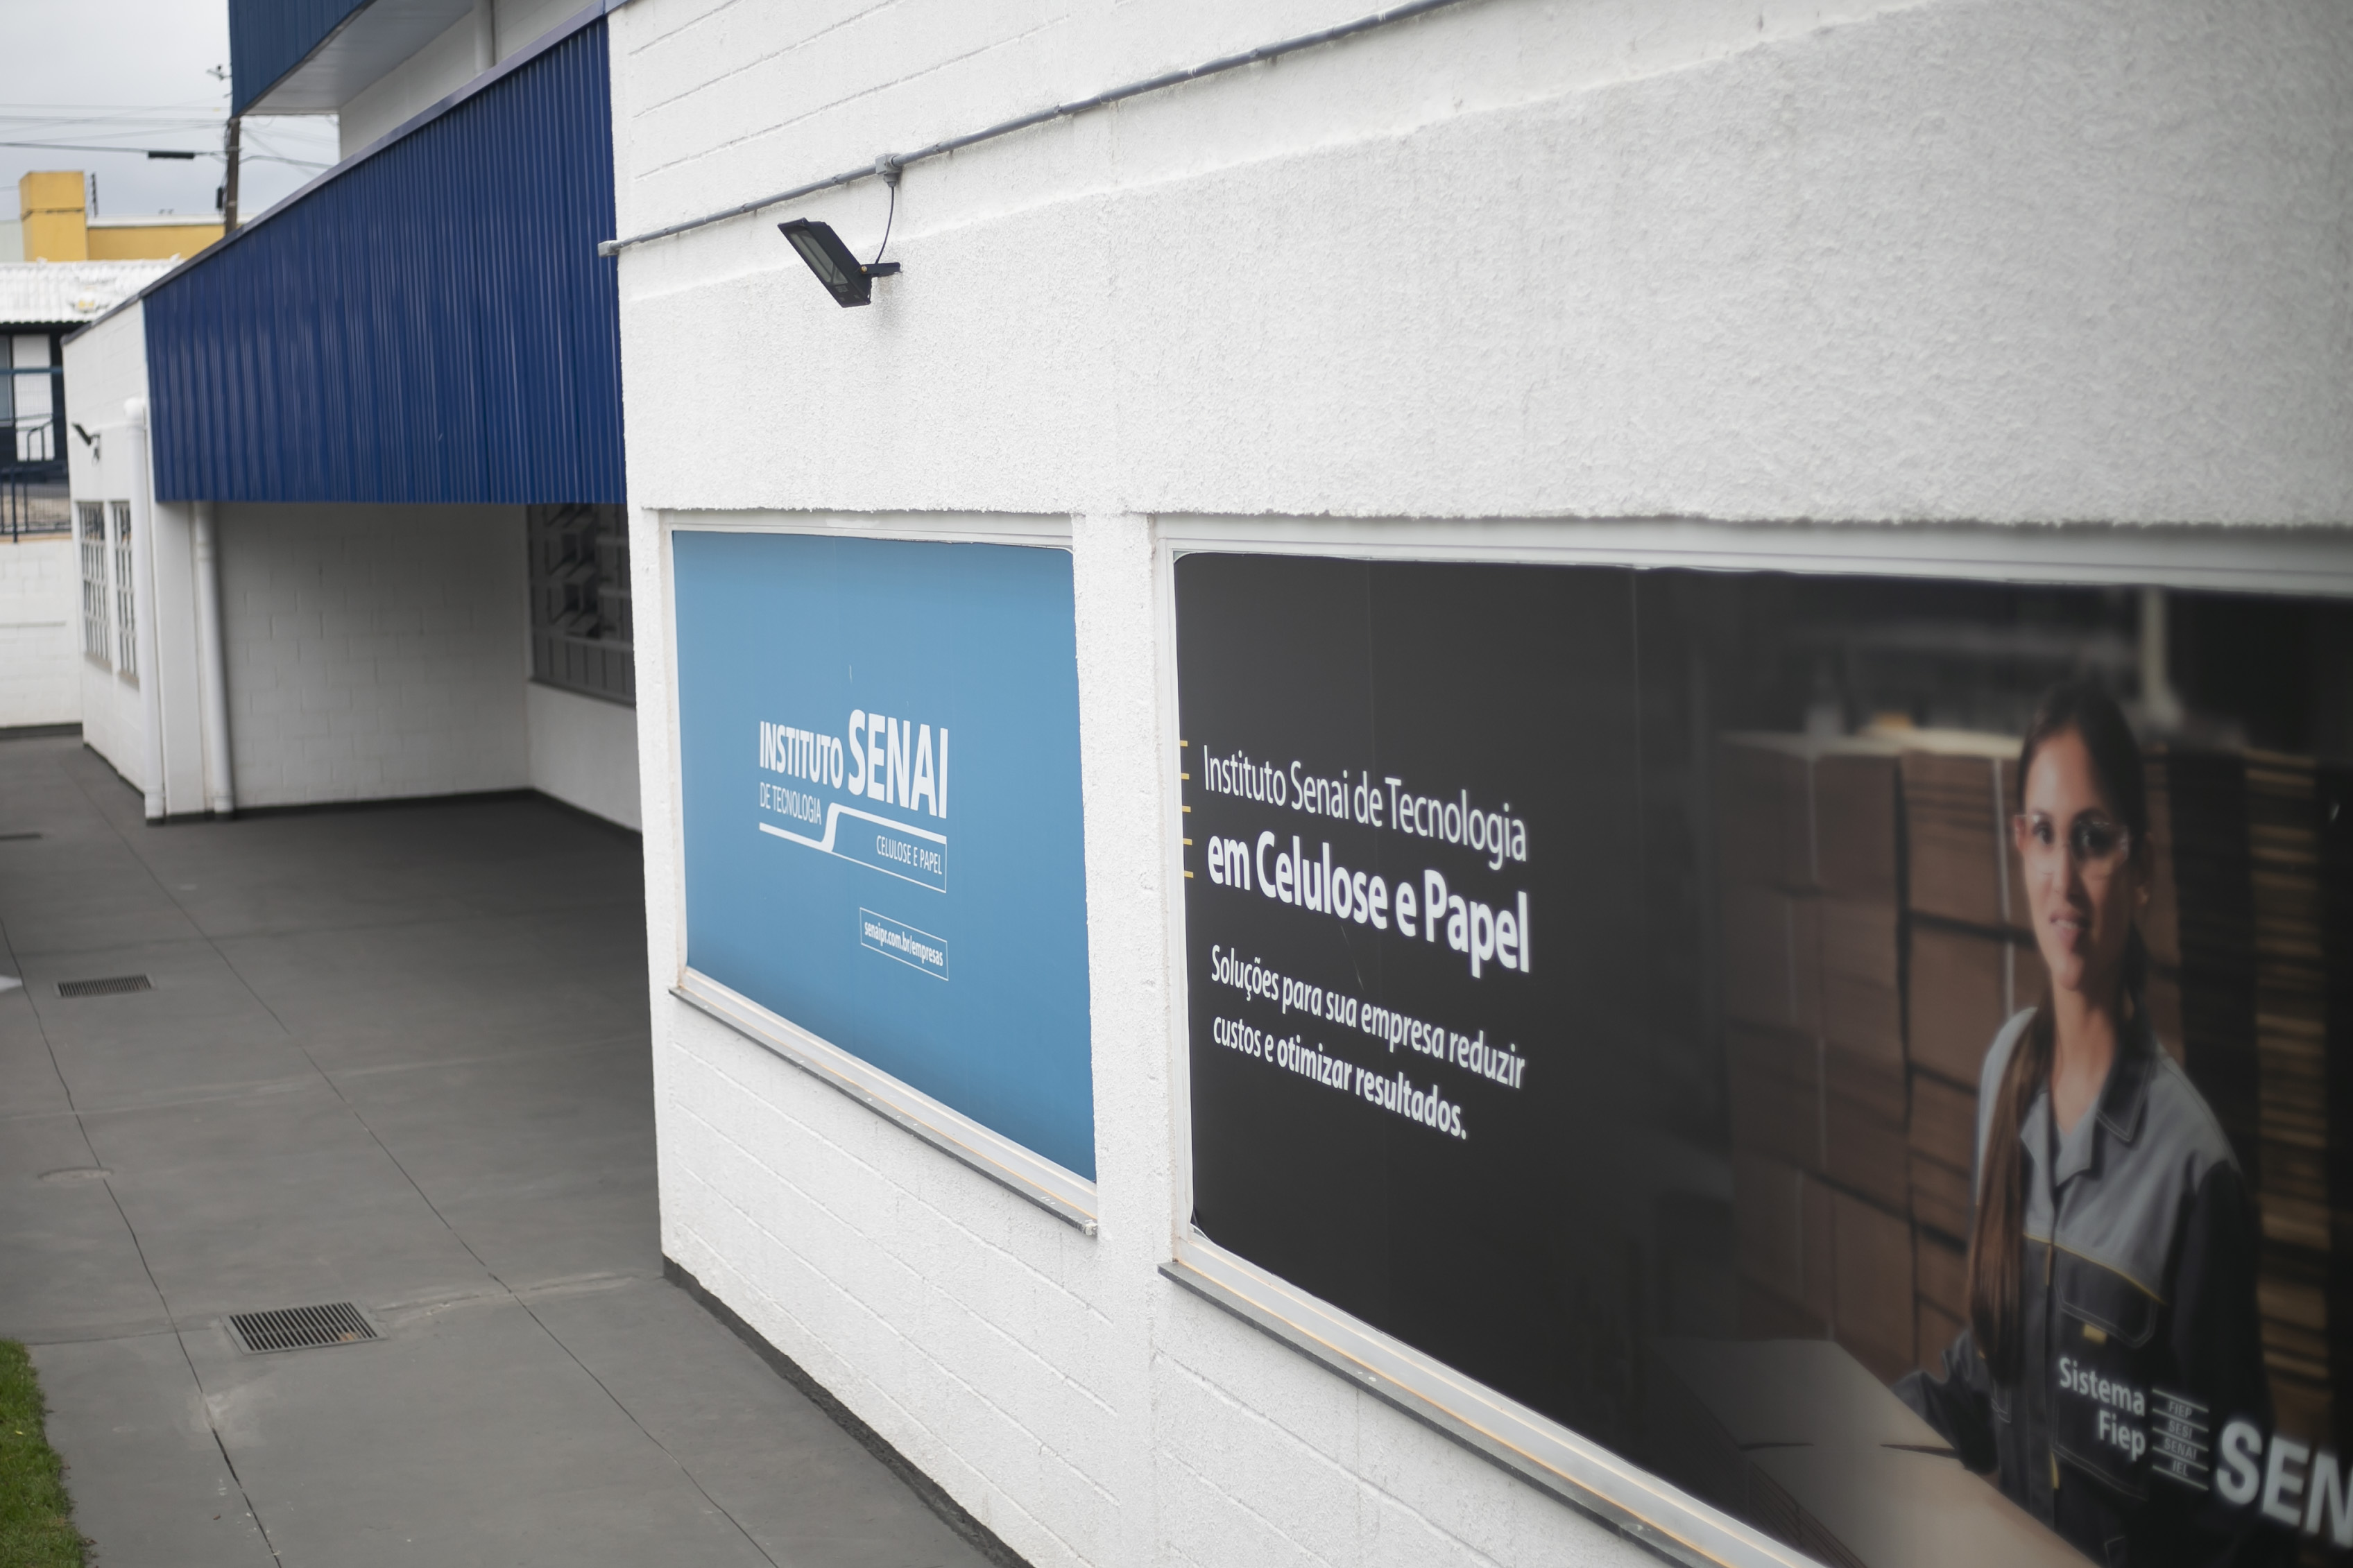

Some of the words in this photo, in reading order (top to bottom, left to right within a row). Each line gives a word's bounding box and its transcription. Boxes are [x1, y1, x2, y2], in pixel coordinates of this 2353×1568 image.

[760, 721, 844, 789] INSTITUTO
[848, 709, 948, 819] SENAI
[760, 782, 771, 809] DE
[773, 785, 821, 825] TECNOLOGIA
[1204, 745, 1286, 807] Instituto
[1290, 760, 1349, 820] Senai
[1354, 770, 1383, 828] de
[1385, 777, 1527, 870] Tecnologia
[876, 835, 912, 864] CELULOSE
[914, 847, 918, 866] E
[920, 849, 942, 875] PAPEL
[1208, 835, 1250, 890] em
[1256, 831, 1387, 929] Celulose
[1395, 881, 1417, 937] e
[1424, 869, 1529, 979] Papel
[864, 920, 943, 967] senaipr.com.br/empresas
[1211, 944, 1278, 1001] Soluções
[1282, 976, 1322, 1014] para
[1326, 990, 1356, 1027] sua
[1361, 1002, 1444, 1059] empresa
[1449, 1030, 1525, 1089] reduzir
[1213, 1015, 1260, 1057] custos
[1265, 1034, 1274, 1062] e
[1277, 1034, 1352, 1090] otimizar
[1355, 1067, 1467, 1139] resultados.
[2059, 1357, 2145, 1416] Sistema
[2168, 1402, 2192, 1418] FIEP
[2098, 1410, 2146, 1461] Fiep
[2164, 1438, 2197, 1461] SENAI
[2168, 1420, 2192, 1440] SESI
[2173, 1461, 2189, 1477] IEL
